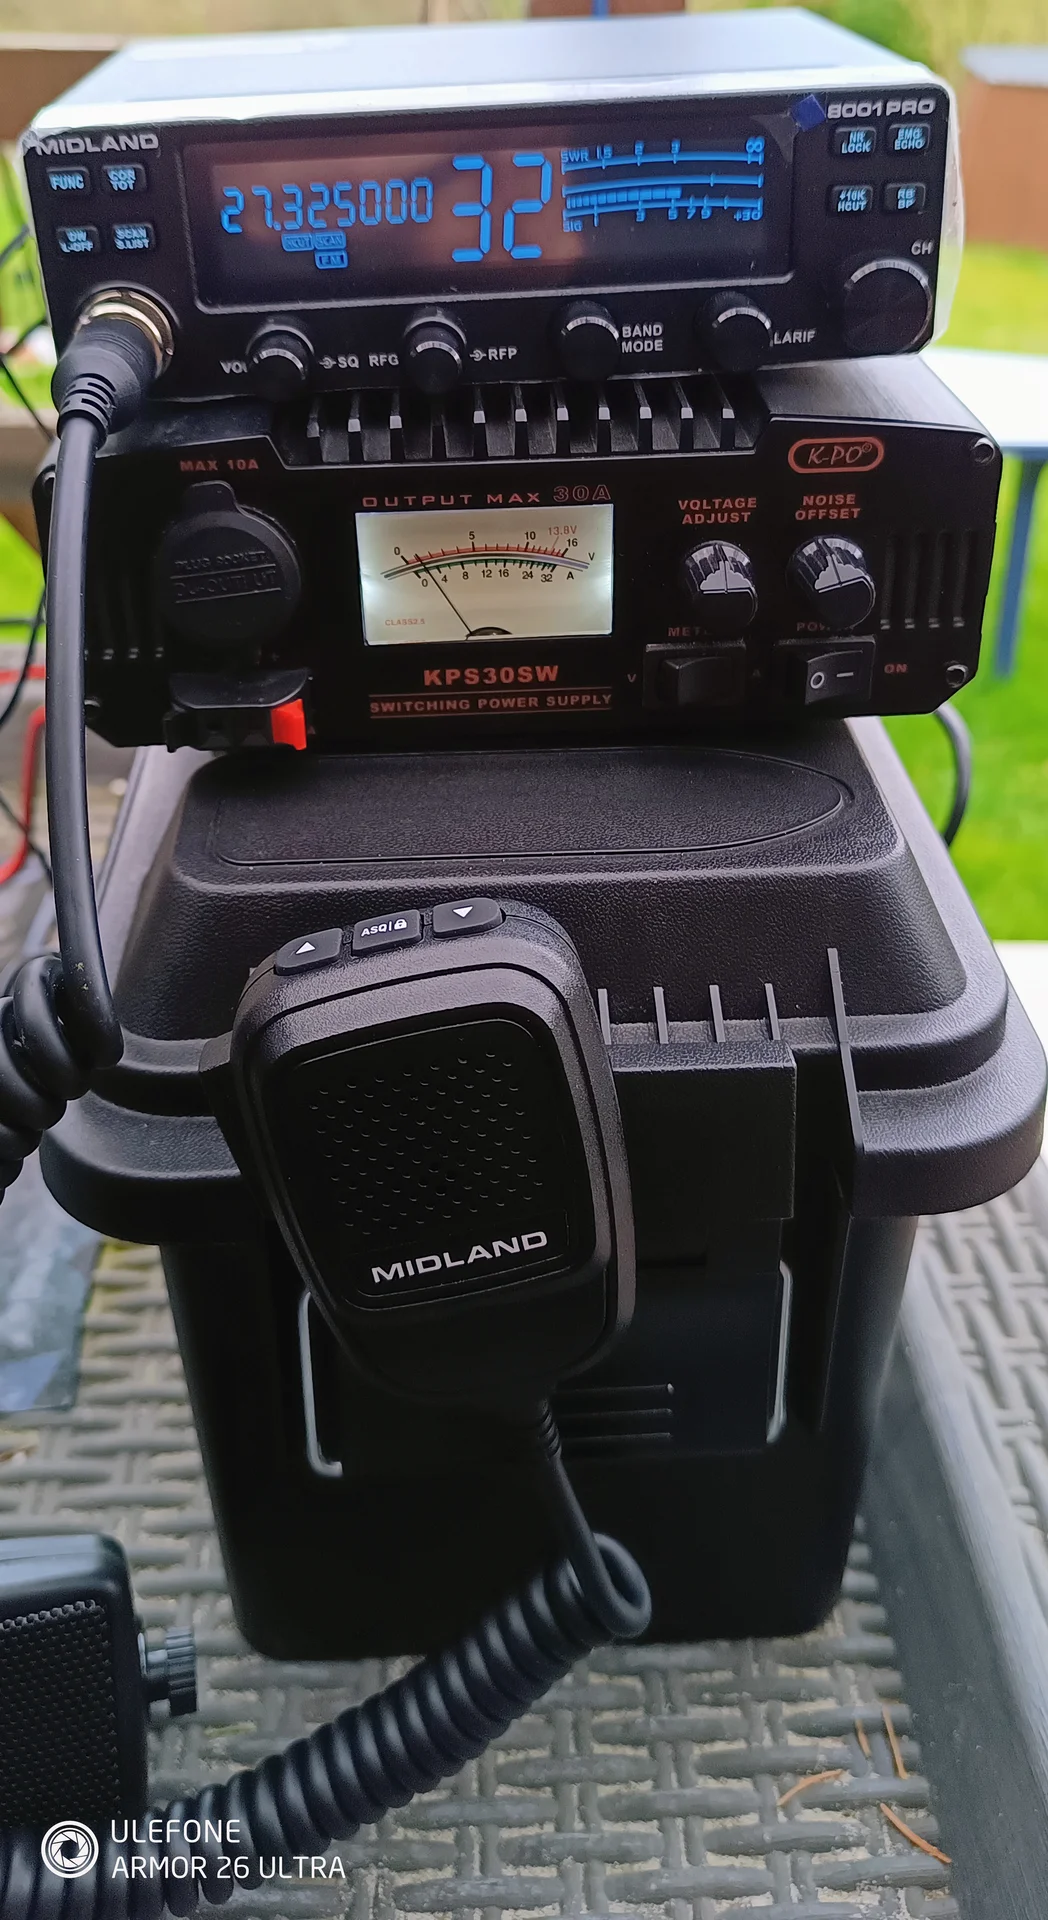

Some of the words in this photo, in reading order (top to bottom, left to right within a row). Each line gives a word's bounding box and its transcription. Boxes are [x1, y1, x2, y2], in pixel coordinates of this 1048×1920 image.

[827, 103, 882, 119] 8001
[886, 100, 936, 116] PRO
[35, 133, 159, 156] MIDLAND
[841, 141, 872, 154] LOCK
[894, 138, 925, 151] ECHO
[561, 148, 589, 162] SWR
[49, 173, 85, 191] FUNC
[221, 177, 433, 234] 27.325000
[451, 153, 552, 263] 32
[115, 228, 147, 240] SCAN
[911, 239, 935, 256] CH
[622, 324, 663, 338] BAND
[773, 329, 817, 345] LARIF
[621, 339, 663, 353] MODE
[337, 355, 360, 369] SQ
[369, 352, 399, 367] RFG
[487, 347, 518, 361] RFP
[180, 460, 218, 471] MAX
[227, 459, 259, 470] 10A
[362, 494, 472, 507] OUTPUT
[486, 492, 540, 504] MAX
[553, 484, 611, 502] 30A
[803, 494, 856, 506] NOISE
[678, 497, 757, 511] VOLTAGE
[682, 512, 751, 525] ADJUST
[795, 508, 861, 521] OFFSET
[468, 531, 475, 540] 5
[524, 531, 536, 540] 10
[548, 525, 578, 536] 13.8V
[566, 538, 578, 548] 16
[393, 547, 401, 556] 0
[588, 552, 595, 561] V
[441, 574, 448, 584] 4
[462, 571, 469, 581] 8
[481, 569, 493, 579] 12
[498, 569, 510, 578] 16
[522, 570, 534, 580] 24
[540, 573, 553, 583] 32
[566, 571, 575, 580] A
[421, 579, 429, 588] 0
[667, 626, 713, 637] MET
[884, 663, 908, 674] ON
[423, 665, 559, 686] KPS30SW
[627, 673, 637, 683] V
[369, 699, 471, 714] SWITCHING
[477, 697, 539, 710] POWER
[546, 694, 612, 708] SUPPLY
[361, 924, 387, 937] ASQ
[371, 1231, 548, 1284] MIDLAND
